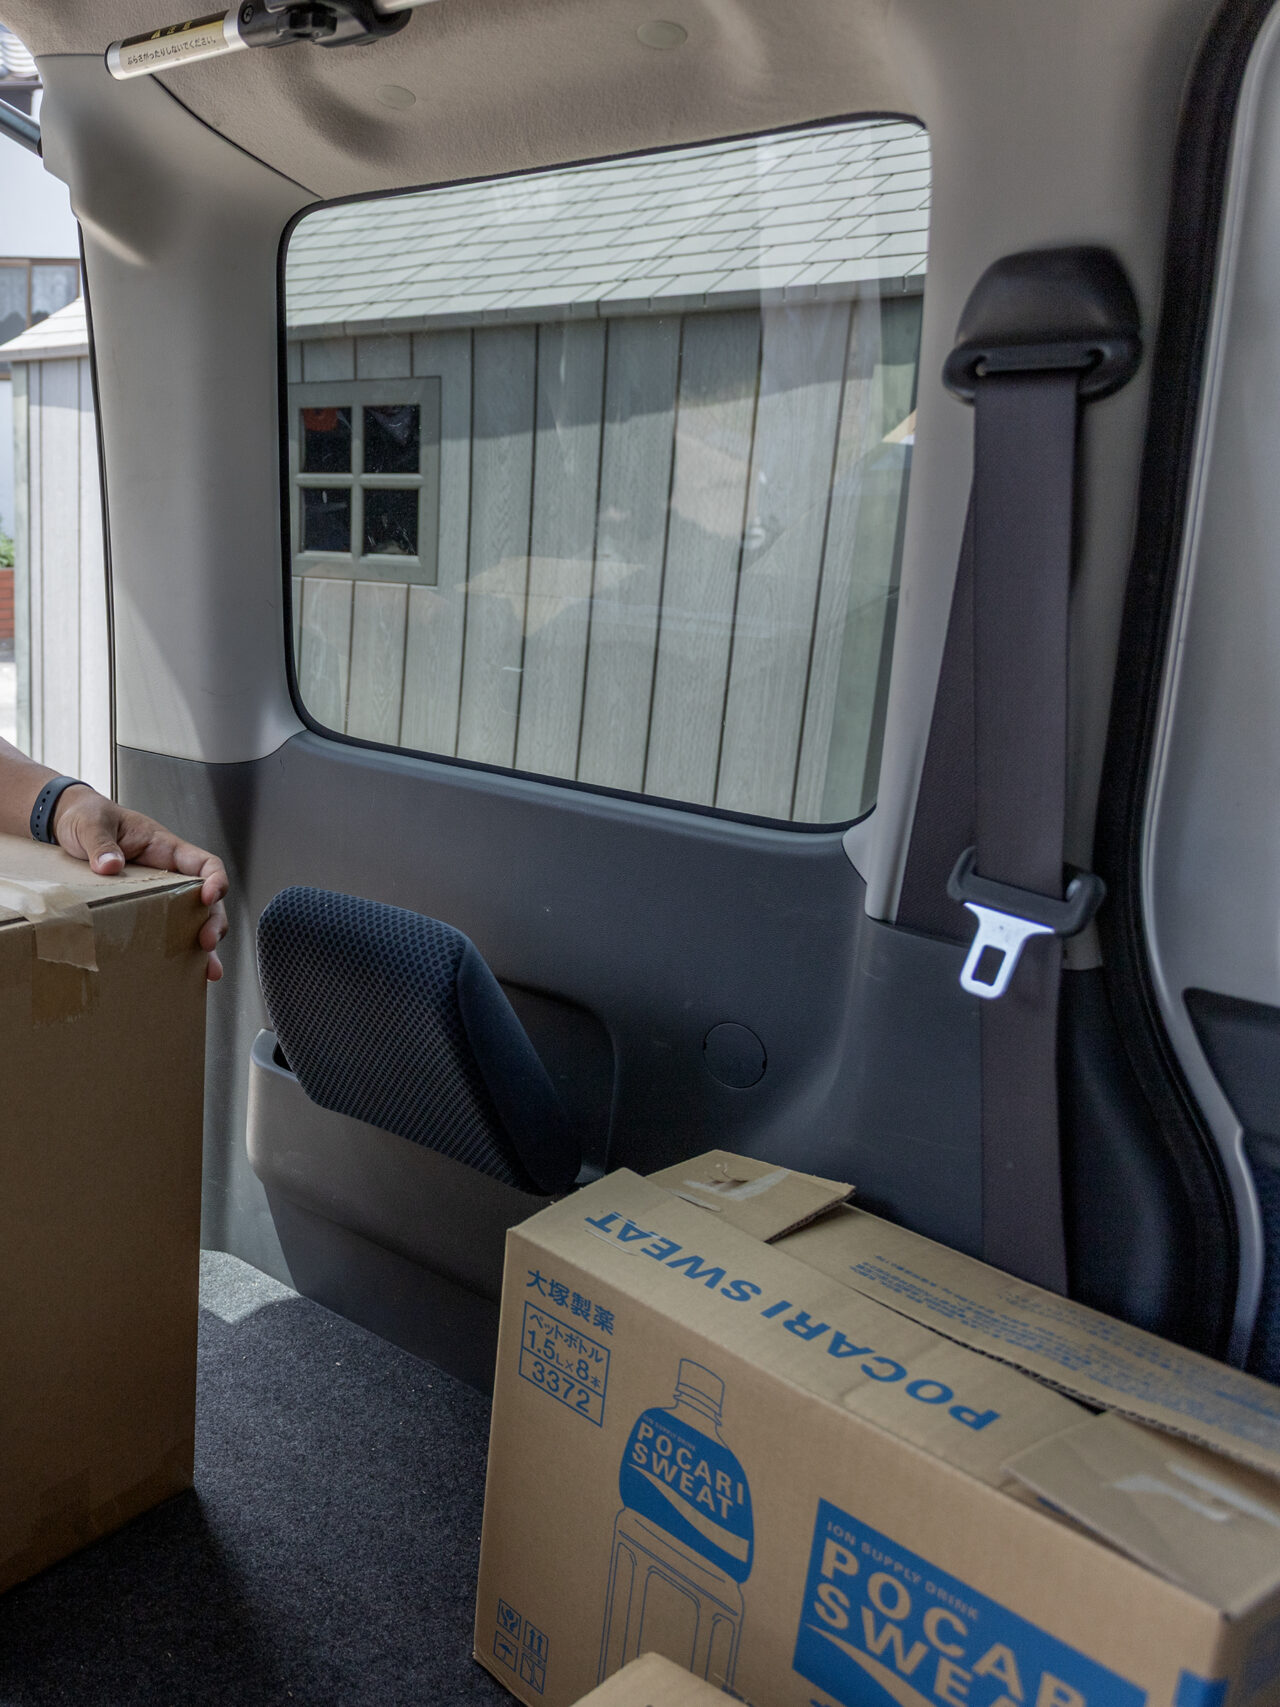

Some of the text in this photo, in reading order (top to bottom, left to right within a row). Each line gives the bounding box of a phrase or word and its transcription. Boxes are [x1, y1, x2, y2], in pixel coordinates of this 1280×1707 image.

[584, 1211, 763, 1302] SWEAT
[526, 1269, 615, 1336] 大塚製薬
[529, 1313, 604, 1364] ペットボトル
[531, 1360, 591, 1414] 3372
[760, 1300, 1001, 1432] POCARI
[632, 1441, 734, 1519] SWEAT
[637, 1421, 744, 1505] POCARI
[826, 1520, 856, 1545] ION
[861, 1541, 922, 1584] SUPPLY
[813, 1582, 1018, 1707] SWE
